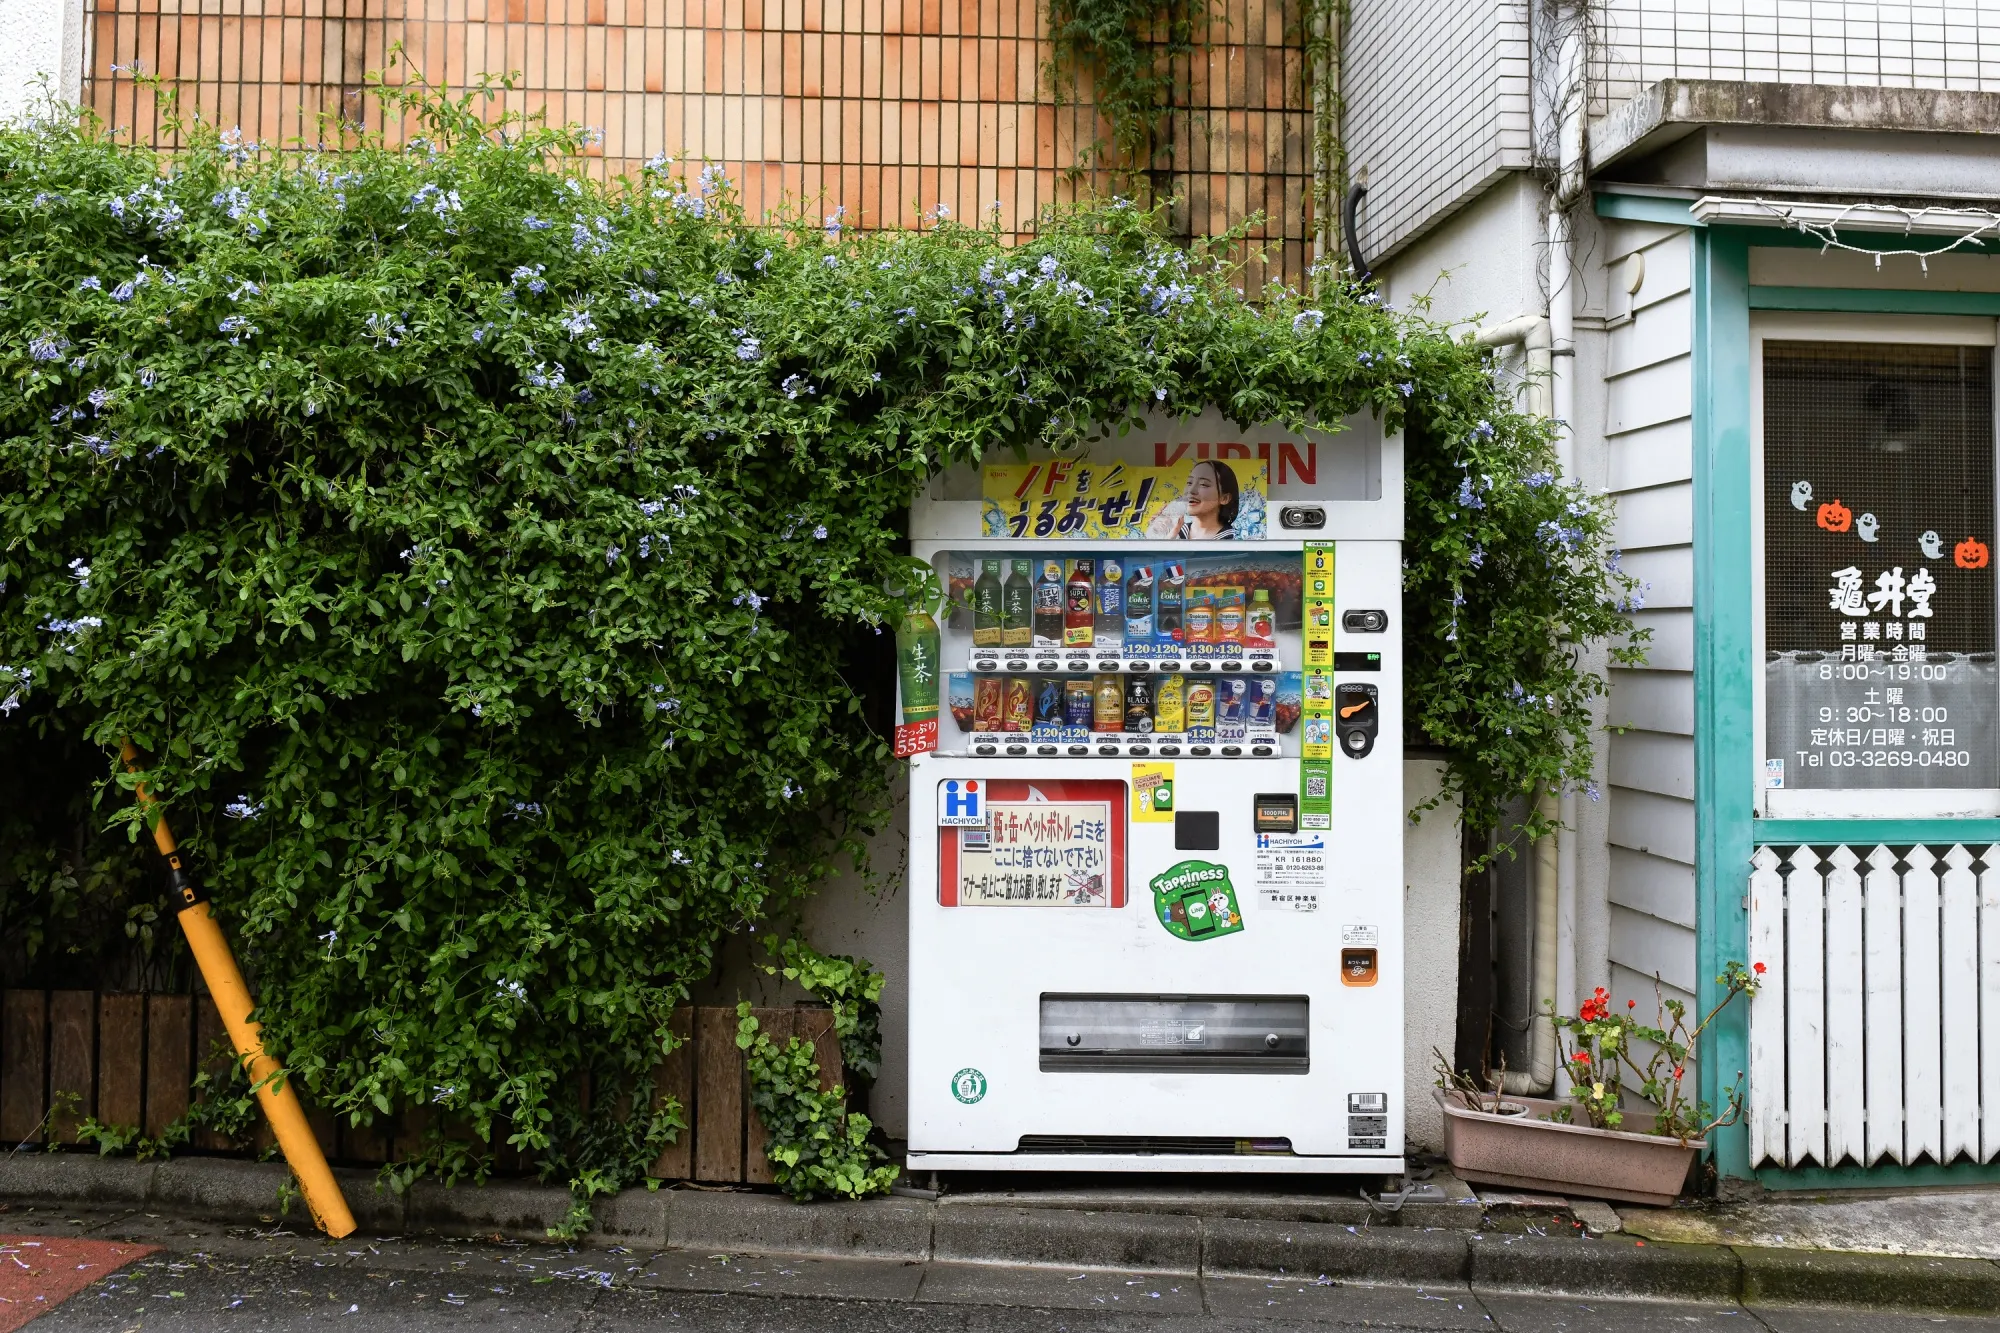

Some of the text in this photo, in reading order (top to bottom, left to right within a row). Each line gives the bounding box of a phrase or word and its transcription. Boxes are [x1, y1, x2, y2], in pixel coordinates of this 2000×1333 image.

[1014, 461, 1094, 499] ノドを
[982, 588, 993, 613] 生茶
[1011, 589, 1022, 613] 生茶
[1840, 621, 1926, 641] 営業時間
[1124, 644, 1150, 653] ¥120
[1152, 644, 1179, 653] ¥120
[1186, 645, 1214, 654] ¥130
[1216, 645, 1242, 654] ¥130
[1840, 644, 1926, 662] 月曜〜金曜
[912, 643, 932, 683] 生茶
[1863, 687, 1904, 705] 土曜
[897, 721, 936, 739] たっぷり
[1032, 728, 1059, 737] ¥120
[1061, 728, 1089, 737] ¥120
[1187, 729, 1215, 738] ¥130
[1217, 729, 1245, 738] ¥210
[1810, 728, 1955, 746] 定休日/日曜・祝日
[897, 735, 936, 755] 555ml
[1796, 751, 1970, 767] Tel 03-3269-0480
[994, 846, 1104, 869] ここに捨てないで下さい
[963, 873, 1063, 900] マナー向上にご協力お願い致します
[1154, 869, 1224, 894] Tappiness
